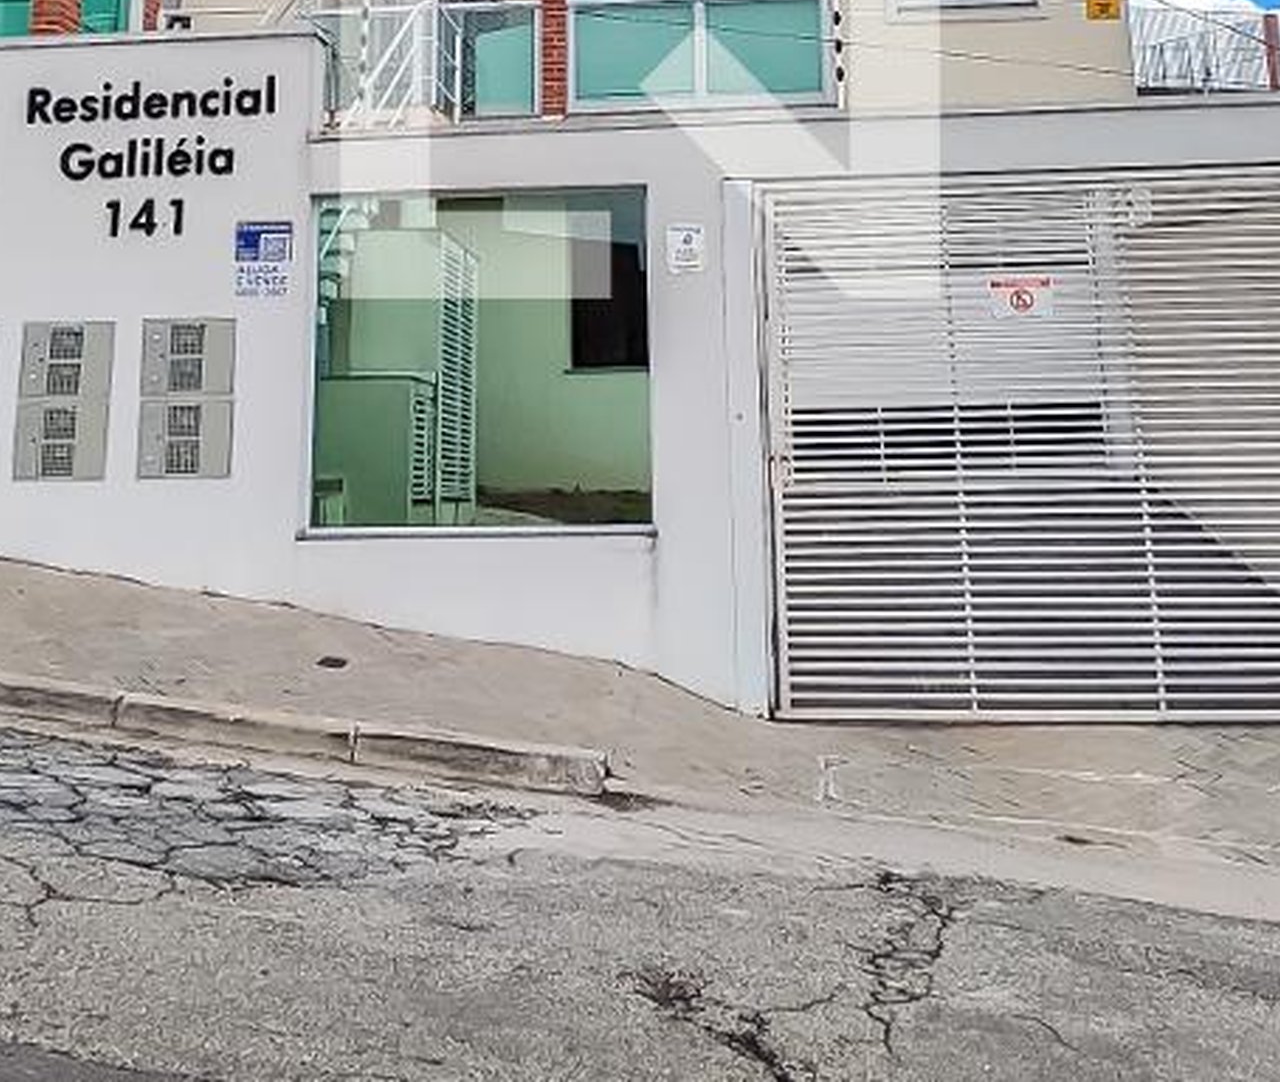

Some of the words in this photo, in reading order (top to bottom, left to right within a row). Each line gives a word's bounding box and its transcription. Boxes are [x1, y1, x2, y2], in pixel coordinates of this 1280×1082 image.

[26, 75, 276, 124] Residencial
[59, 135, 235, 181] Galiléia
[105, 198, 184, 238] 141
